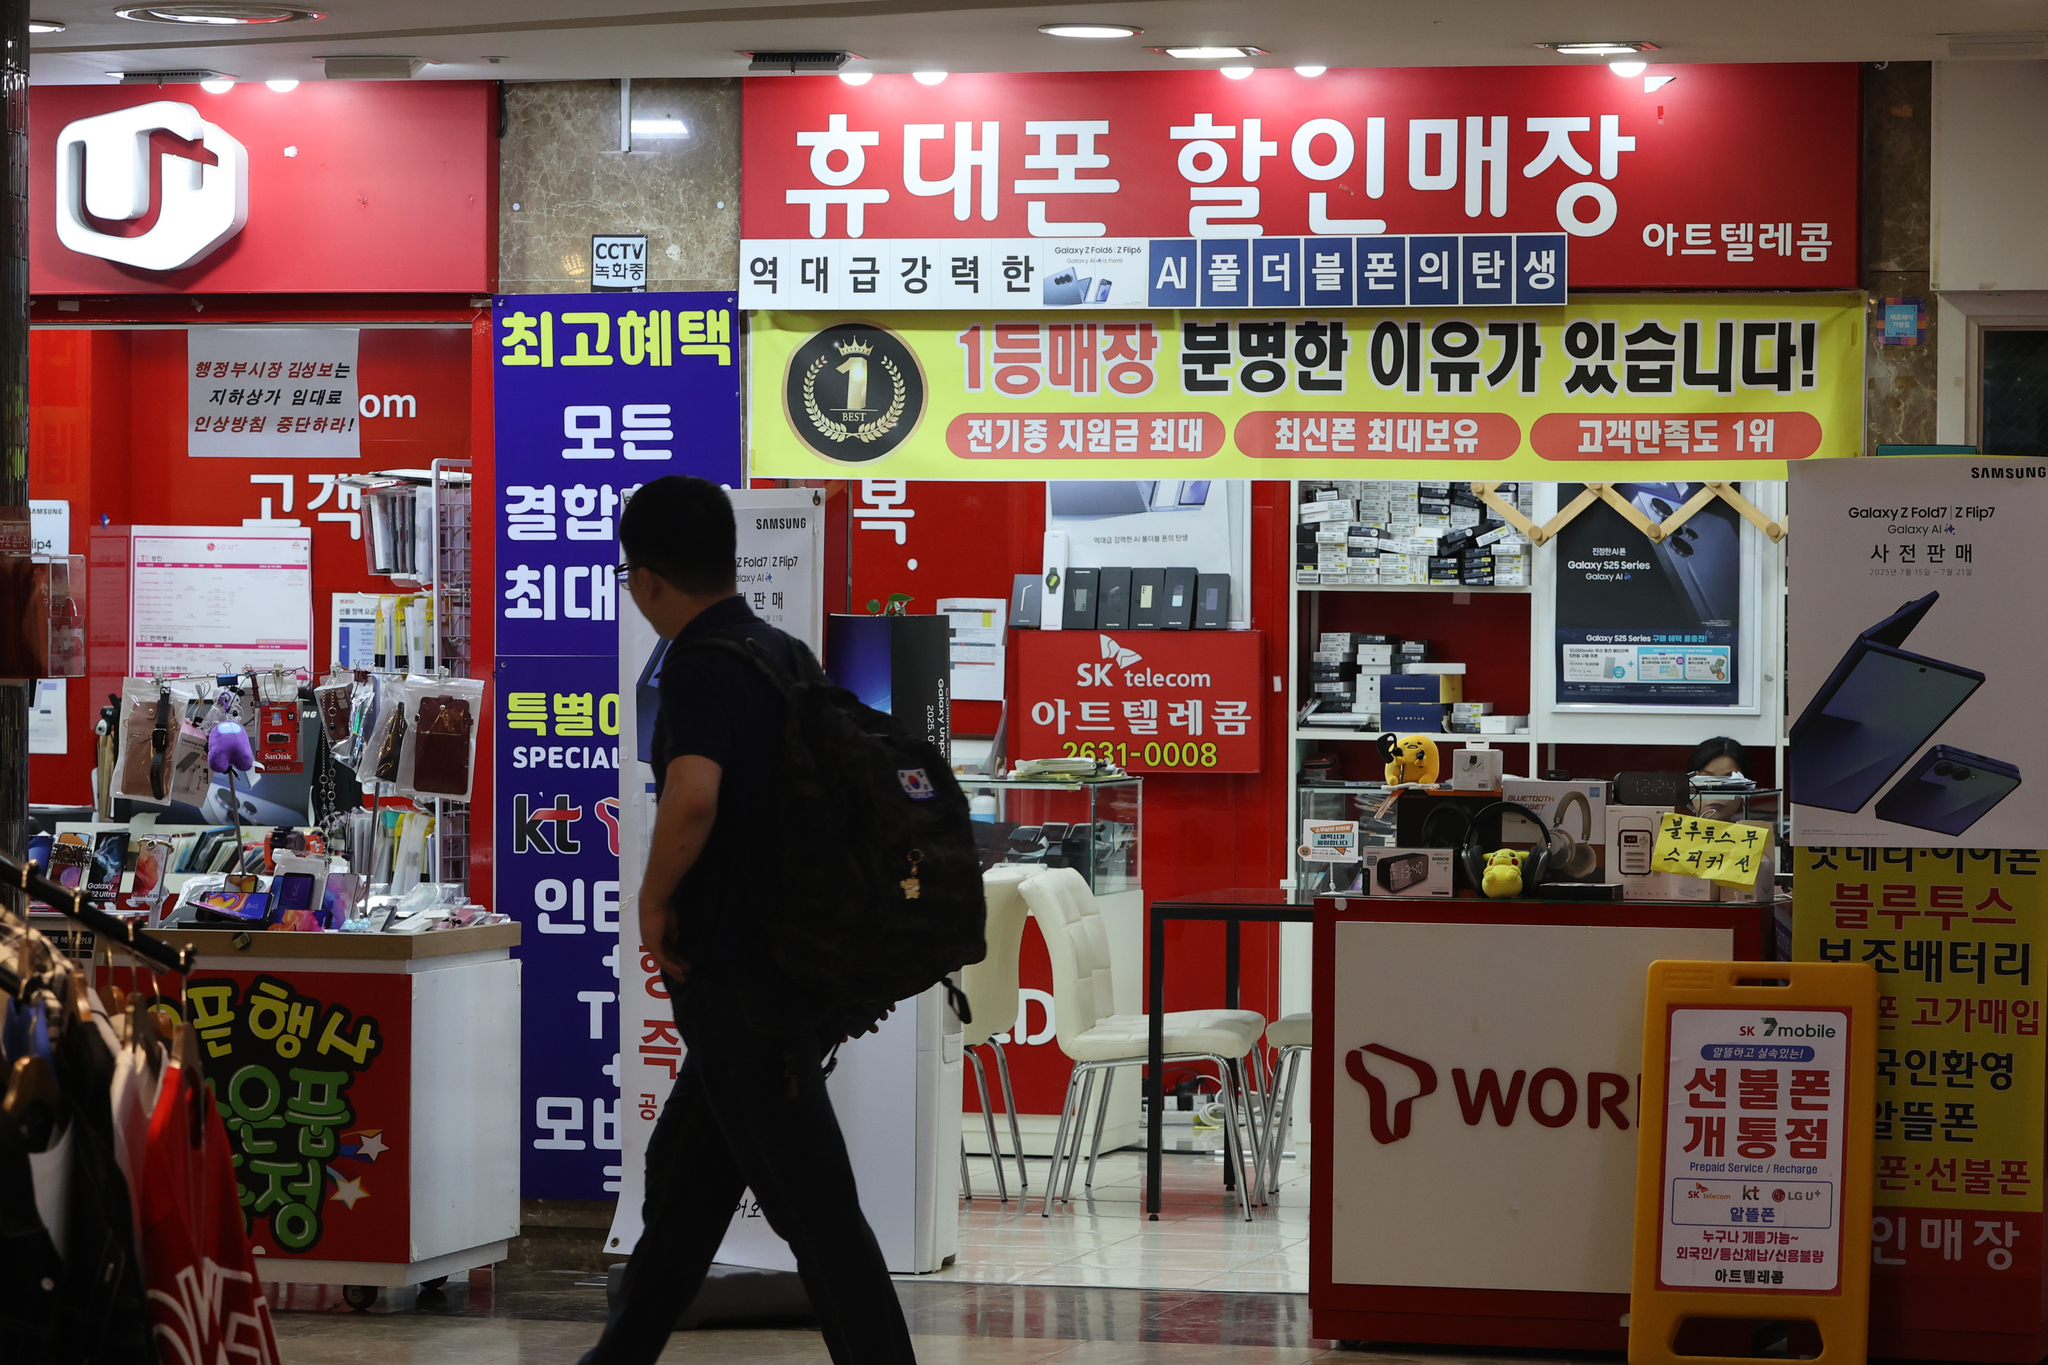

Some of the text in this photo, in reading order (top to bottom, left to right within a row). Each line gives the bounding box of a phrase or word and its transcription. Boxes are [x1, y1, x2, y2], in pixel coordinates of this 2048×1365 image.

[785, 112, 1637, 238] 휴대폰 할인매장
[595, 242, 644, 260] CCTV
[1054, 246, 1084, 255] Galaxy
[1085, 246, 1090, 254] Z
[1091, 246, 1113, 254] Fold6
[1123, 246, 1142, 256] Flip6
[1642, 221, 1833, 263] 아트텔레콤
[595, 262, 644, 281] 녹화중
[501, 308, 732, 367] 최고혜택
[956, 319, 1816, 396] 1등매장 분명한 이유가 있습니다!
[195, 361, 350, 379] 행정부시장 김성보는
[834, 354, 868, 411] 1
[208, 388, 342, 406] 지하상가 임대료
[359, 393, 417, 418] om
[194, 415, 355, 433] 인상방침 중단하라!
[840, 411, 867, 423] BEST
[561, 403, 674, 460] 모든
[967, 418, 1203, 453] 전기종 지원금 최대
[1275, 419, 1480, 454] 최신폰 최대보유
[1576, 418, 1775, 454] 고객만족도 1위
[1970, 466, 2047, 479] SAMSUNG
[242, 473, 361, 540] 고객
[1847, 506, 1995, 522] Galaxy Z Fold7 Z Flip7
[755, 517, 807, 530] SAMSUNG
[1887, 524, 1942, 536] Galaxy AI
[31, 539, 52, 555] lip4
[1093, 534, 1189, 545] 역대급 강력한 AI 폴더블 폰의 탄생
[1592, 547, 1612, 556] 진정한
[743, 555, 768, 568] Fold7
[772, 556, 779, 567] Z
[779, 555, 799, 570] Flip7
[1567, 560, 1651, 571] Galaxy S25 Series
[756, 573, 765, 582] AI
[1585, 572, 1614, 582] Galaxy
[1869, 568, 1973, 577] 2025년 7월 15일 7월 21일
[1586, 634, 1613, 644] Galaxy
[1614, 634, 1628, 642] S25
[1628, 634, 1651, 642] Series
[1652, 634, 1667, 643] 구매
[1076, 662, 1211, 688] SK telecom
[937, 678, 945, 724] Galaxy
[926, 705, 935, 733] 2025.
[1031, 699, 1252, 737] 아트텔레콤
[1062, 741, 1218, 769] 2631-0008
[1507, 795, 1555, 803] BLUETOOTH
[513, 793, 583, 854] kt
[1663, 847, 1724, 869] 스피커
[87, 882, 115, 891] Galaxy
[99, 890, 117, 898] Ultra
[1829, 882, 2017, 932] 블루투스
[248, 981, 375, 1065] 행사
[577, 990, 617, 1040] T
[1911, 997, 2040, 1036] 고가매입
[1739, 1026, 1755, 1037] SK
[1712, 1046, 1804, 1060] 알뜰하고 실속있는!
[1683, 1067, 1831, 1112] 선불폰
[1451, 1067, 1639, 1131] WOR
[205, 1064, 350, 1158] 은품
[1874, 1100, 1979, 1143] 알뜰폰
[1682, 1115, 1827, 1160] 개통점
[1689, 1162, 1818, 1176] Prepaid Service Recharge
[1687, 1185, 1822, 1201] SK telecom kt LG U+
[1729, 1206, 1776, 1223] 알뜰폰
[1702, 1230, 1799, 1245] 누구나 개통가능~
[1675, 1247, 1825, 1264] 외국인/통신체납/신용불량
[1714, 1268, 1785, 1284] 아트텔레콤
